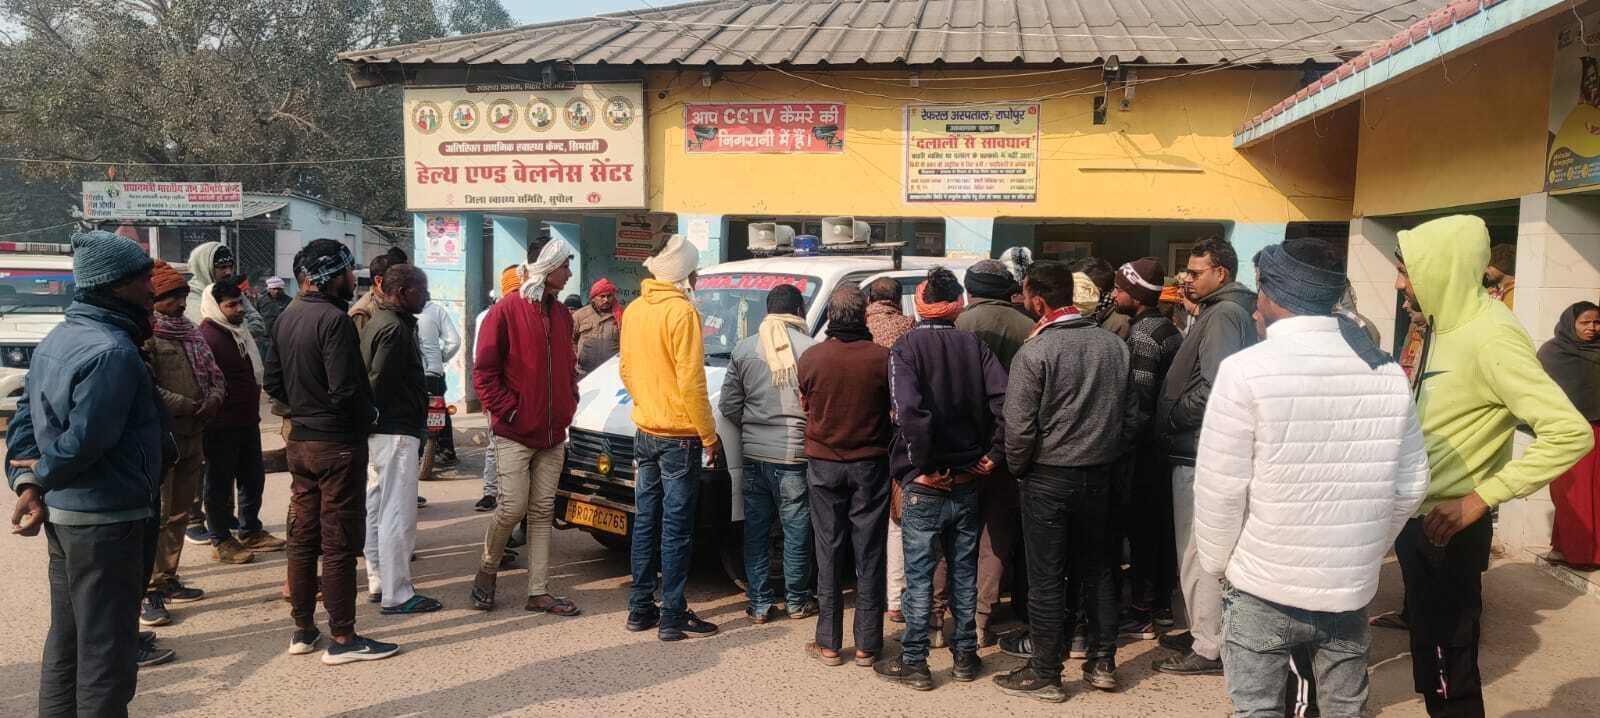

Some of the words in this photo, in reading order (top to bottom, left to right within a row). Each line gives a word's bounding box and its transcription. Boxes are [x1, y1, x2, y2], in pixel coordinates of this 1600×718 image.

[691, 110, 719, 125] आप
[723, 108, 775, 125] CCTV
[780, 105, 814, 124] कैमरे
[818, 105, 840, 124] की
[920, 109, 949, 120] रेफरल
[950, 109, 992, 121] अस्पताल,
[996, 107, 1026, 125] राघोपुर
[444, 142, 481, 153] अतिरिक्त
[483, 141, 515, 153] प्राथमिक
[516, 141, 544, 152] स्वास्थ्य
[718, 128, 775, 148] निगरानी
[779, 128, 791, 147] में
[963, 134, 976, 149] से
[414, 160, 459, 184] हेल्थ
[463, 165, 507, 183] एण्ड
[512, 159, 584, 183] वेलनेस
[589, 157, 635, 183] सेंटर
[464, 194, 487, 205] जिला
[489, 194, 515, 205] स्वास्थ्य
[518, 193, 547, 205] समिति,
[549, 193, 574, 206] सुपौल
